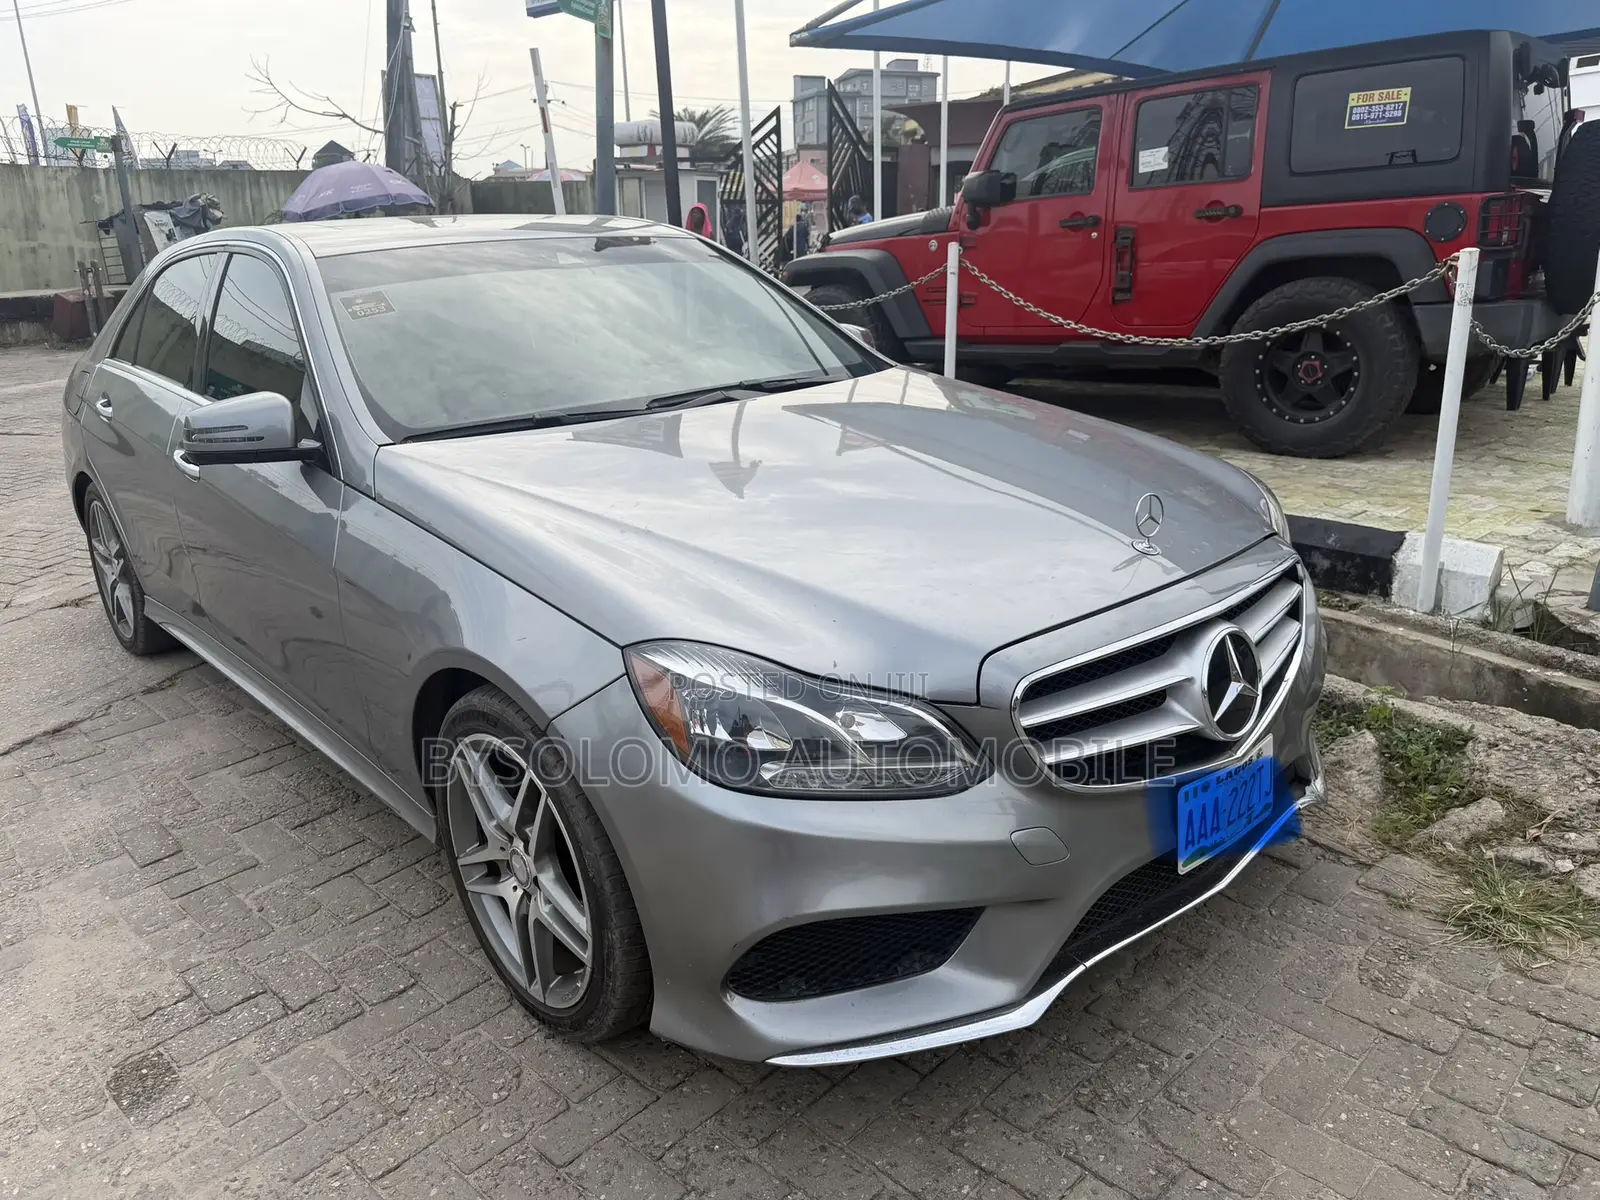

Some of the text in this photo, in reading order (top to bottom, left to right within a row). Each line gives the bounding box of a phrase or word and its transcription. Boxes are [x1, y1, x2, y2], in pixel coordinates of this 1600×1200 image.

[1356, 89, 1403, 104] FOR SALE
[1216, 756, 1254, 785] LAGOS
